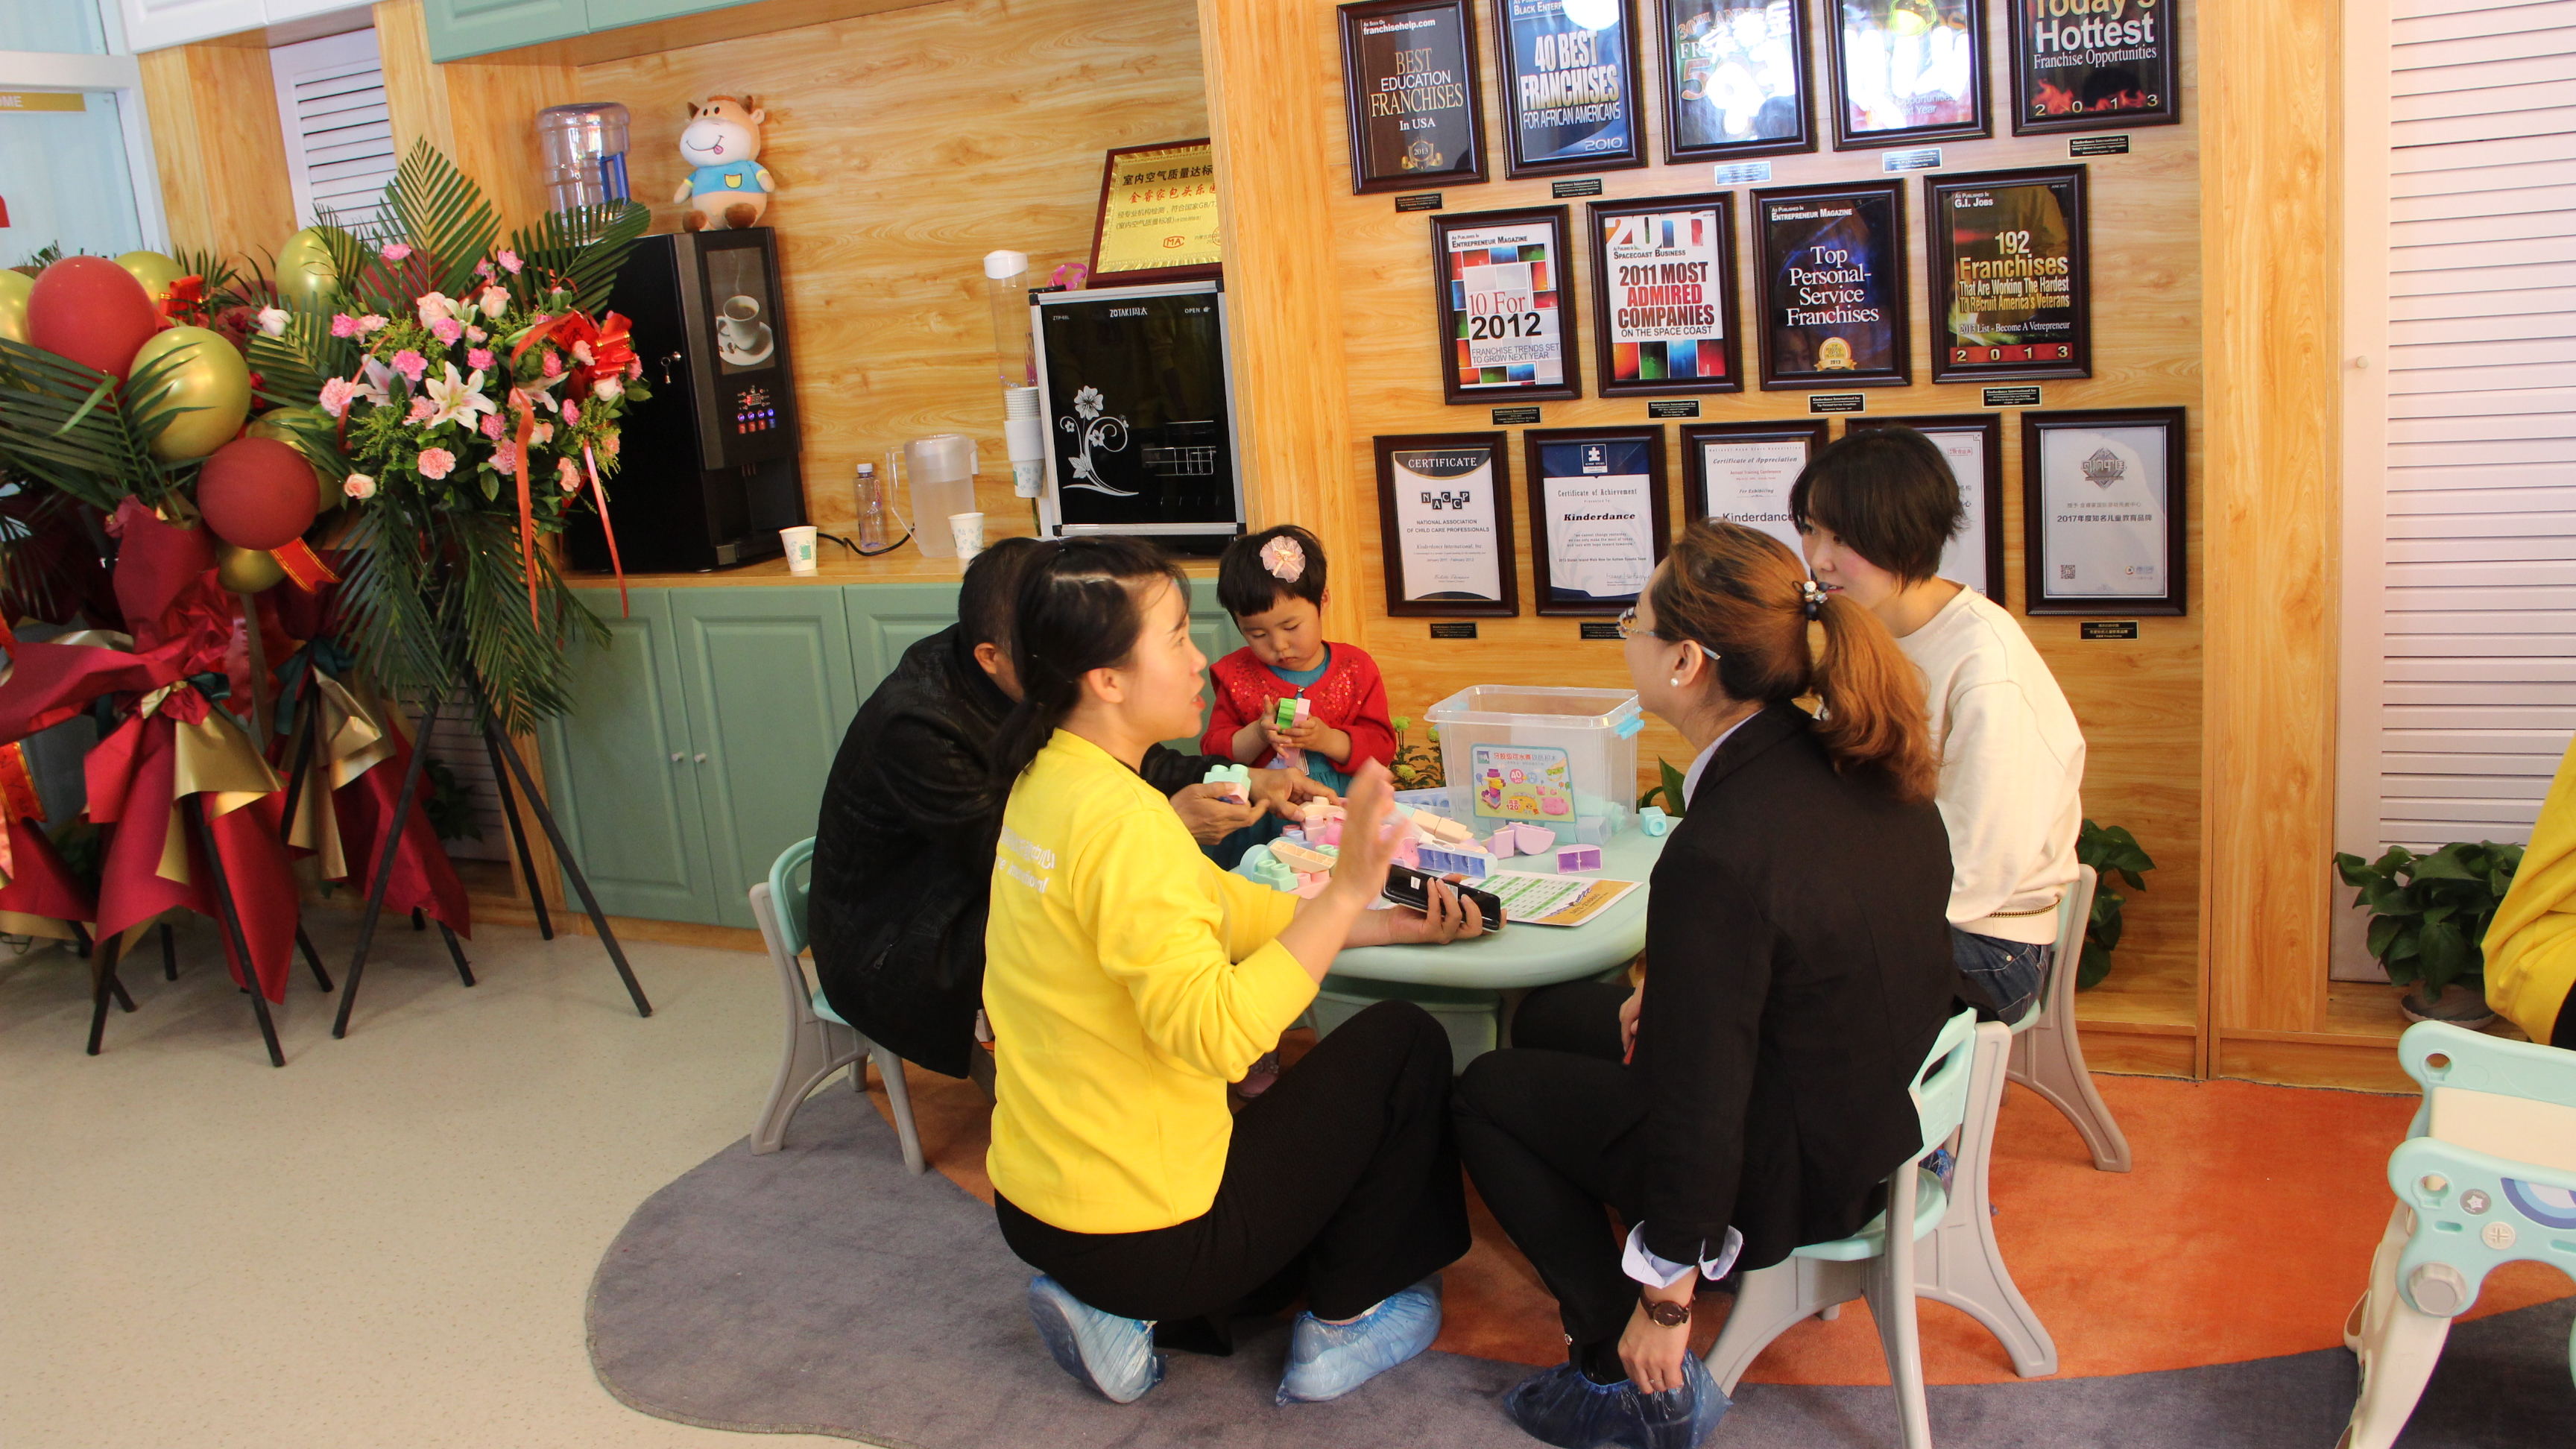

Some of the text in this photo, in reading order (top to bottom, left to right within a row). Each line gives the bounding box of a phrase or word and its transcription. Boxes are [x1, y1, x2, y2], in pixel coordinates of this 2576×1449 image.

[1514, 4, 1535, 16] BLACK
[1363, 19, 1436, 36] franchisehelp.com
[2036, 12, 2155, 54] Hottest
[1395, 48, 1433, 75] BEST
[1535, 30, 1598, 72] 40 BEST
[2033, 43, 2157, 69] Franchise Opportunities
[1381, 70, 1451, 92] EDUCATION
[1521, 64, 1620, 111] FRANCHISES
[1370, 83, 1464, 118] FRANCHISES
[1400, 117, 1436, 131] In USA
[1524, 102, 1621, 130] FOR AFRICAN AMERICANS
[1413, 148, 1429, 156] 2013
[1585, 137, 1623, 151] 2010
[1954, 198, 1994, 208] G.I. JOBS
[1772, 208, 1852, 221] ENTREPRENEUR MAGAZINE
[1167, 238, 1181, 246] MA
[1452, 236, 1527, 248] ENTREPRENEUR MAGAZINE
[1995, 230, 2030, 255] 192
[1614, 249, 1686, 259] SPACECOAST BUSINESS
[1810, 245, 1848, 268] Top
[1619, 262, 1708, 286] 2011 MOST
[1789, 264, 1872, 286] Personal-
[1959, 253, 2068, 280] Franchises
[1627, 284, 1702, 307] ADMIRED
[1799, 285, 1864, 306] Service
[1960, 276, 2069, 297] That Are Working The Hardest
[1469, 291, 1526, 316] 10 For
[1960, 294, 2070, 312] To Recruit America's Veterans
[1617, 305, 1715, 329] COMPANIES
[1786, 305, 1879, 326] Franchises
[1471, 312, 1542, 341] 2012
[1621, 326, 1712, 338] ON THE SPACE COAST
[1960, 321, 2071, 334] 2013 List Become A Vetrepreneur
[1472, 343, 1559, 356] FRANCHISE TRENDS SET
[1472, 351, 1549, 364] TO GROW NEXT YEAR
[1408, 457, 1478, 468] CERTIFICATE
[1564, 513, 1635, 521] Kinderdance
[2056, 514, 2153, 523] 2017年度知名儿童教育品牌
[1511, 770, 1521, 780] 40
